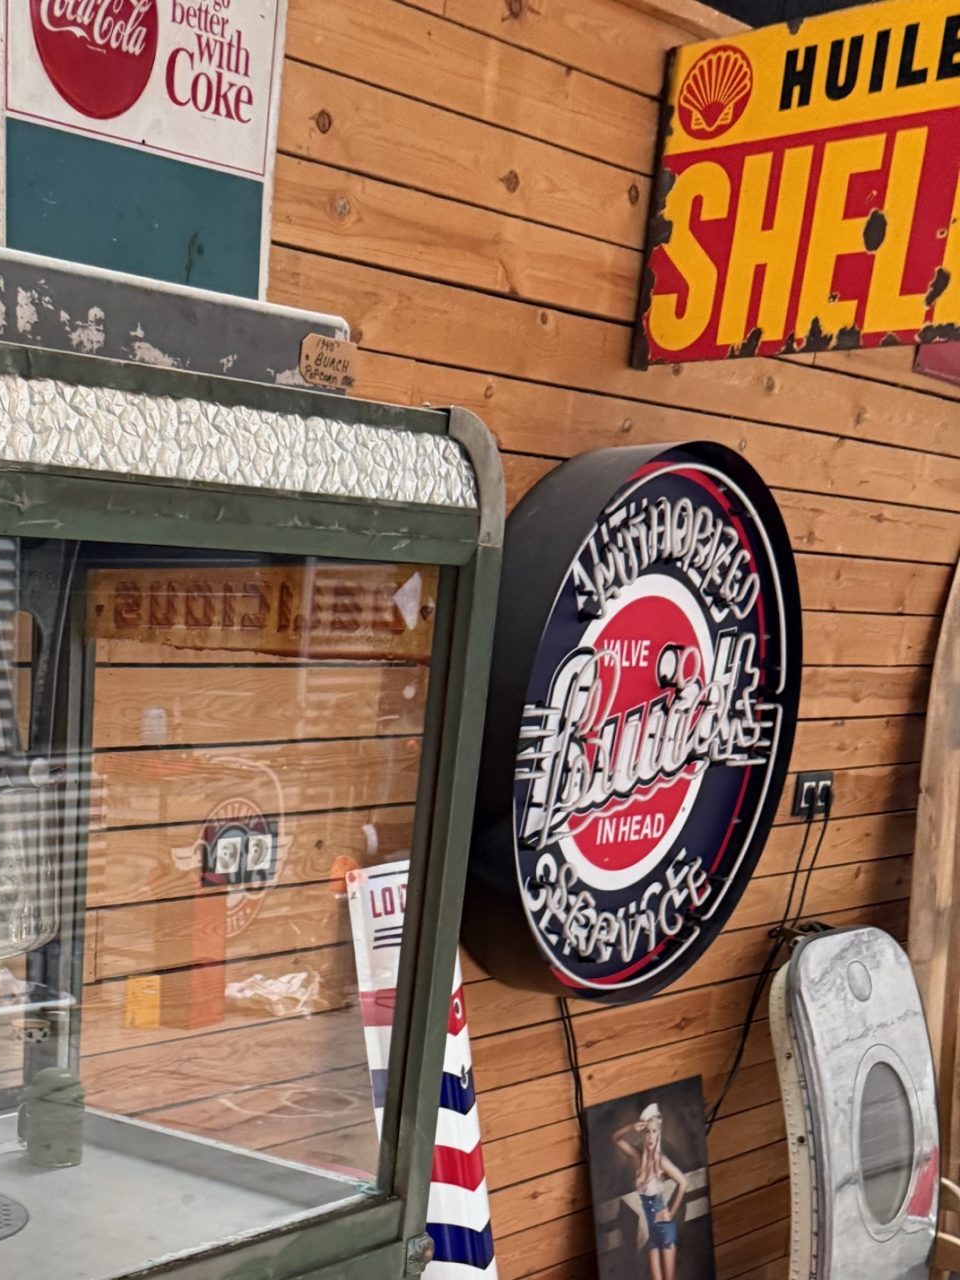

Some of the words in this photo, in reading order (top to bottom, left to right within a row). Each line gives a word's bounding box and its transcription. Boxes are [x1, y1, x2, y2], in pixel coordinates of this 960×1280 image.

[171, 0, 229, 39] better
[195, 29, 250, 77] with
[165, 47, 254, 124] Coke
[314, 351, 350, 373] BURCH
[603, 639, 651, 667] VALVE
[596, 818, 616, 845] IN
[617, 813, 665, 843] HEAD
